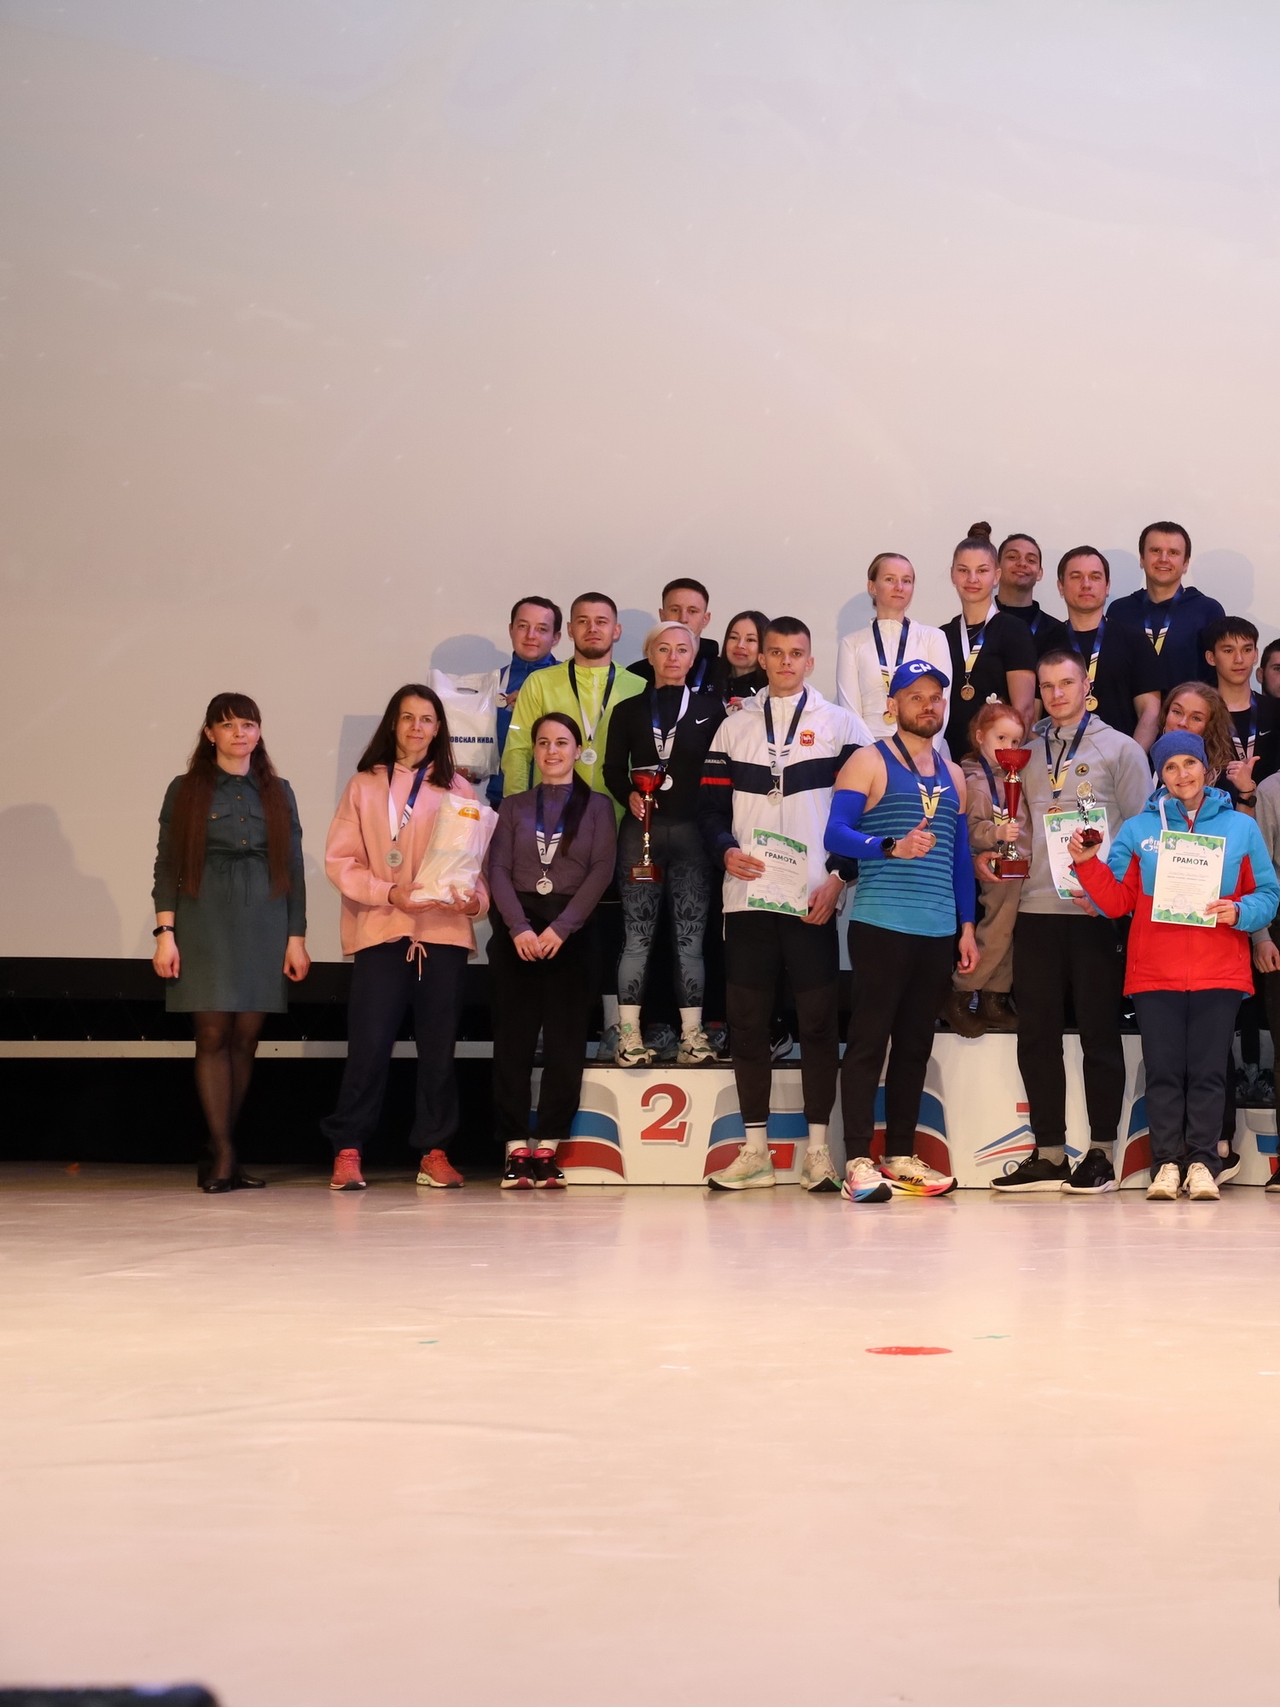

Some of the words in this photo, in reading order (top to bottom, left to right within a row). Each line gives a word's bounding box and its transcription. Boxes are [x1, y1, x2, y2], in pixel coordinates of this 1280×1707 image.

[449, 736, 476, 744] ОВСКАЯ
[477, 736, 494, 744] НИВА
[658, 744, 663, 752] 2
[771, 760, 776, 769] 2
[539, 848, 546, 856] 2
[764, 851, 797, 866] ГРАМОТА
[1172, 856, 1209, 866] ГРАМОТА
[640, 1083, 692, 1146] 2
